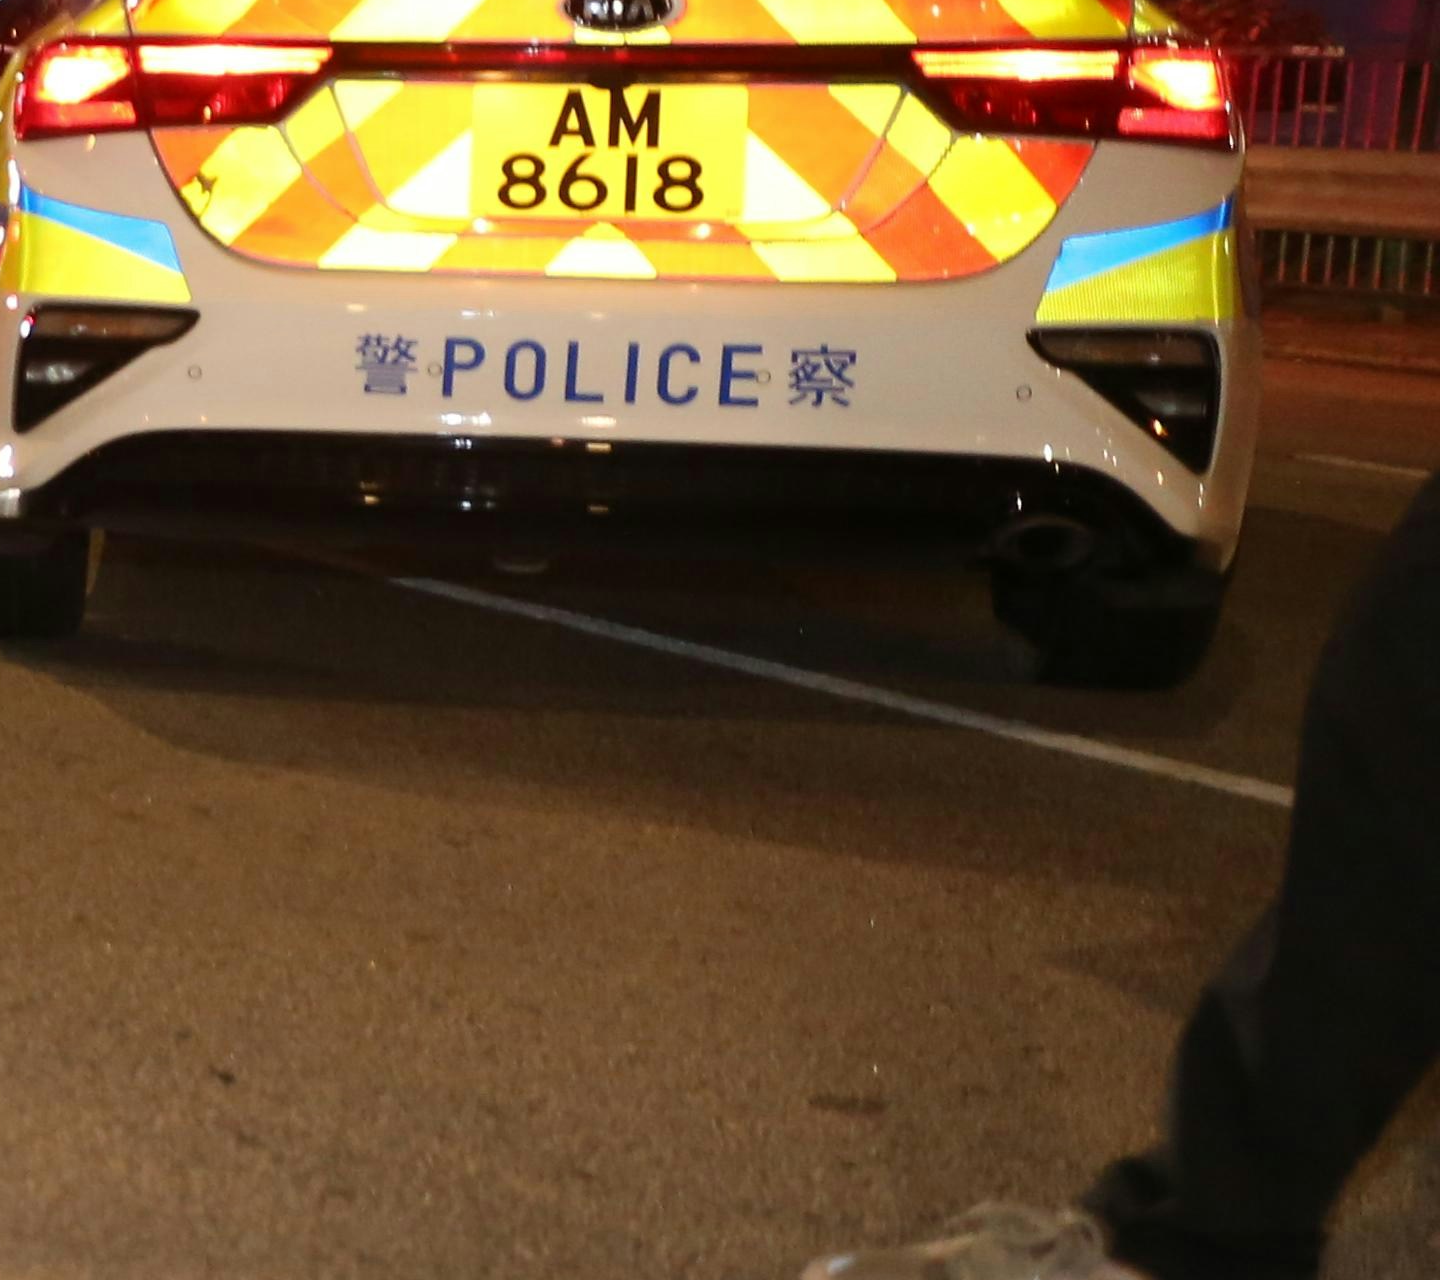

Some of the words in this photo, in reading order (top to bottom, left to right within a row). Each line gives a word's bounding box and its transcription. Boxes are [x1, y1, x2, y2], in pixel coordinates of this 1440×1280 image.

[548, 88, 662, 148] AM
[497, 152, 705, 213] 8618
[354, 332, 420, 395] 警
[441, 336, 764, 408] POLICE
[787, 343, 857, 408] 察
